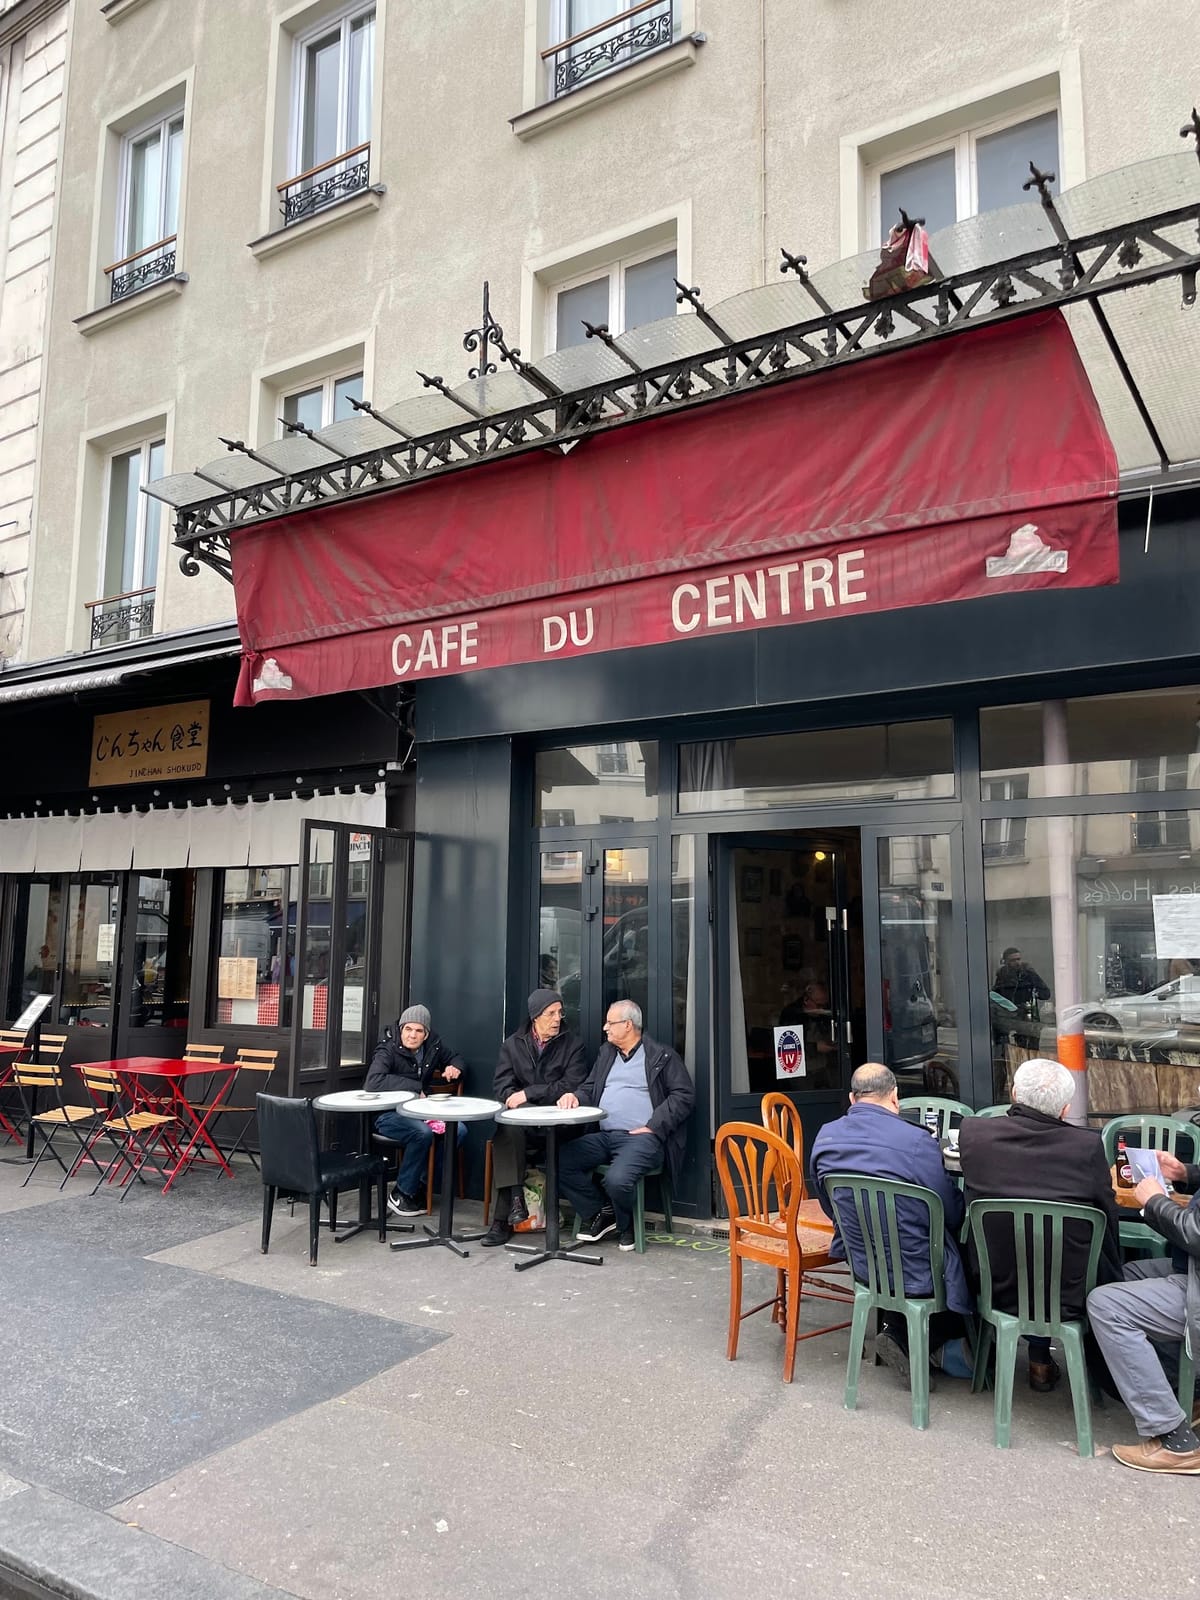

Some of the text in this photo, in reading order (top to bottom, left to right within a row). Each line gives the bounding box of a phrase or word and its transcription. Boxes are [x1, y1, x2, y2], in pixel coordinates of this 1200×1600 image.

[391, 548, 868, 677] CAFE DU CENTRE
[129, 762, 202, 778] JINCHAN SHOKUDO
[785, 1053, 795, 1065] IV
